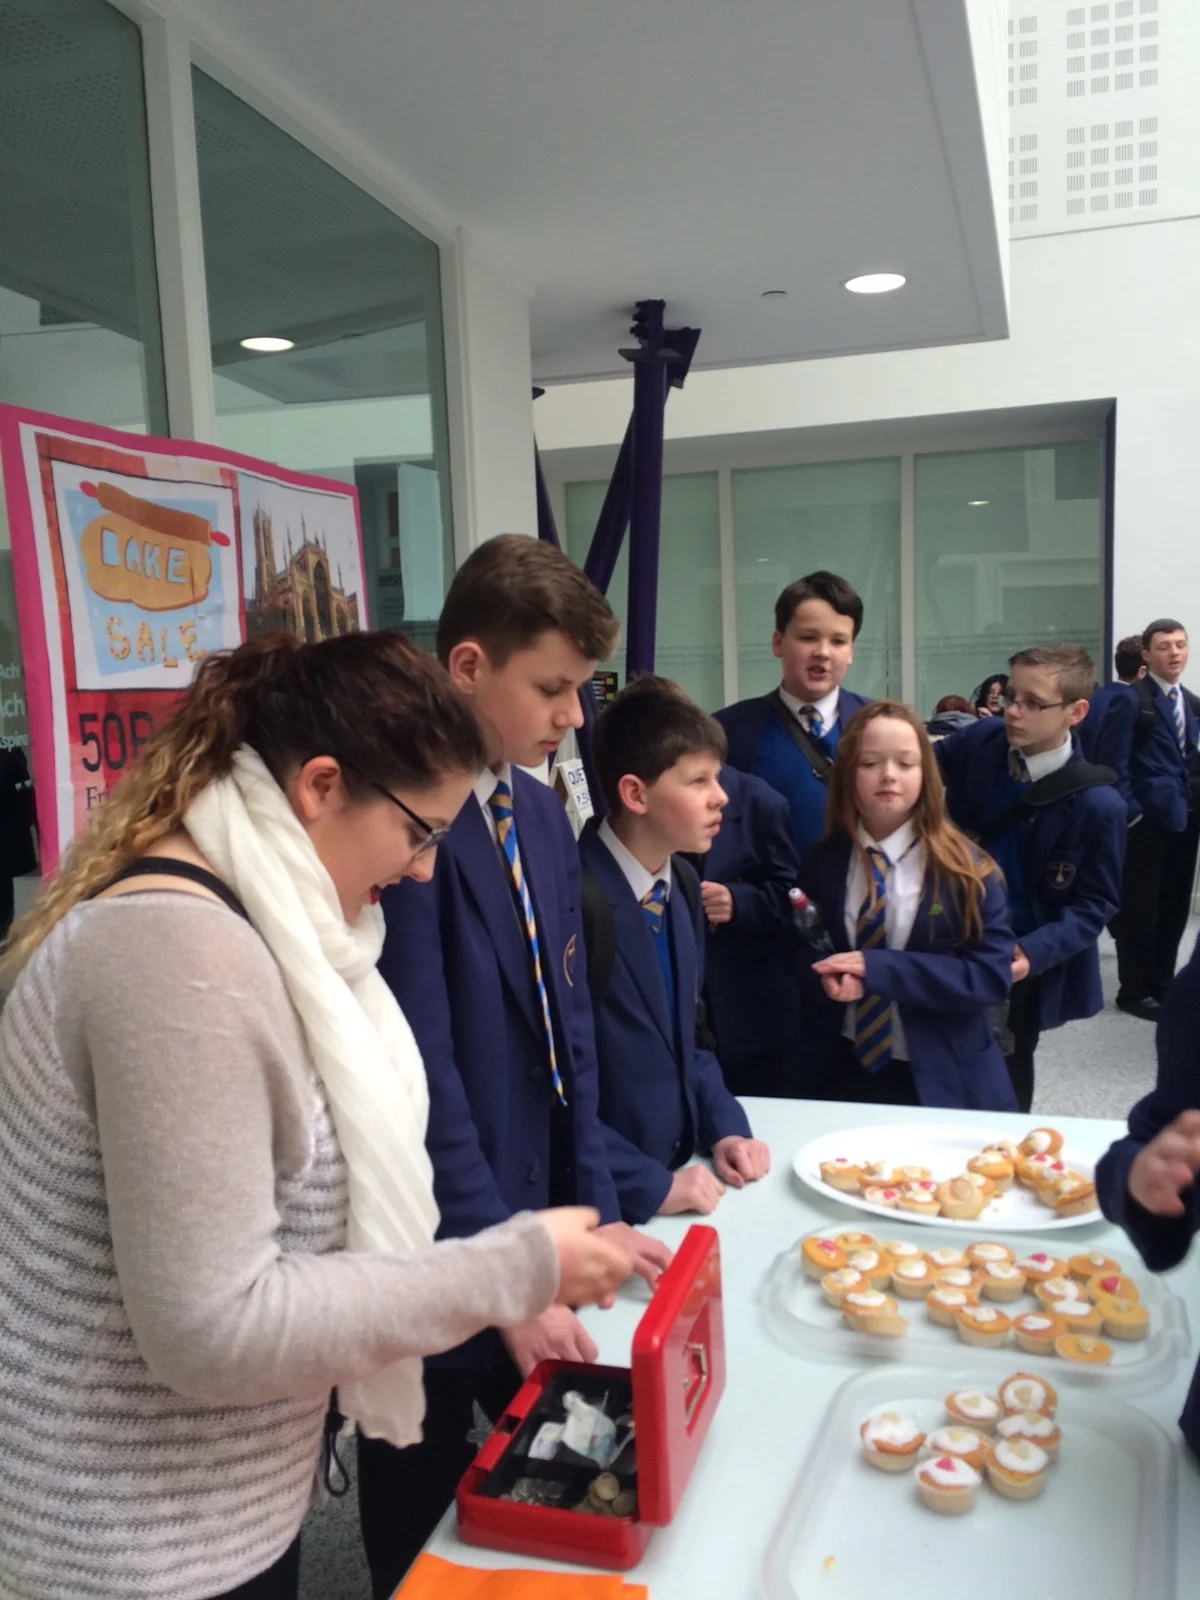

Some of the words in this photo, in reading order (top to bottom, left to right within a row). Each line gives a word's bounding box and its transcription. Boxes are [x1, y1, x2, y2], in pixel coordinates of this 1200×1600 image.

[101, 527, 187, 584] BAKE
[105, 616, 207, 668] SALE
[0, 731, 29, 752] spire
